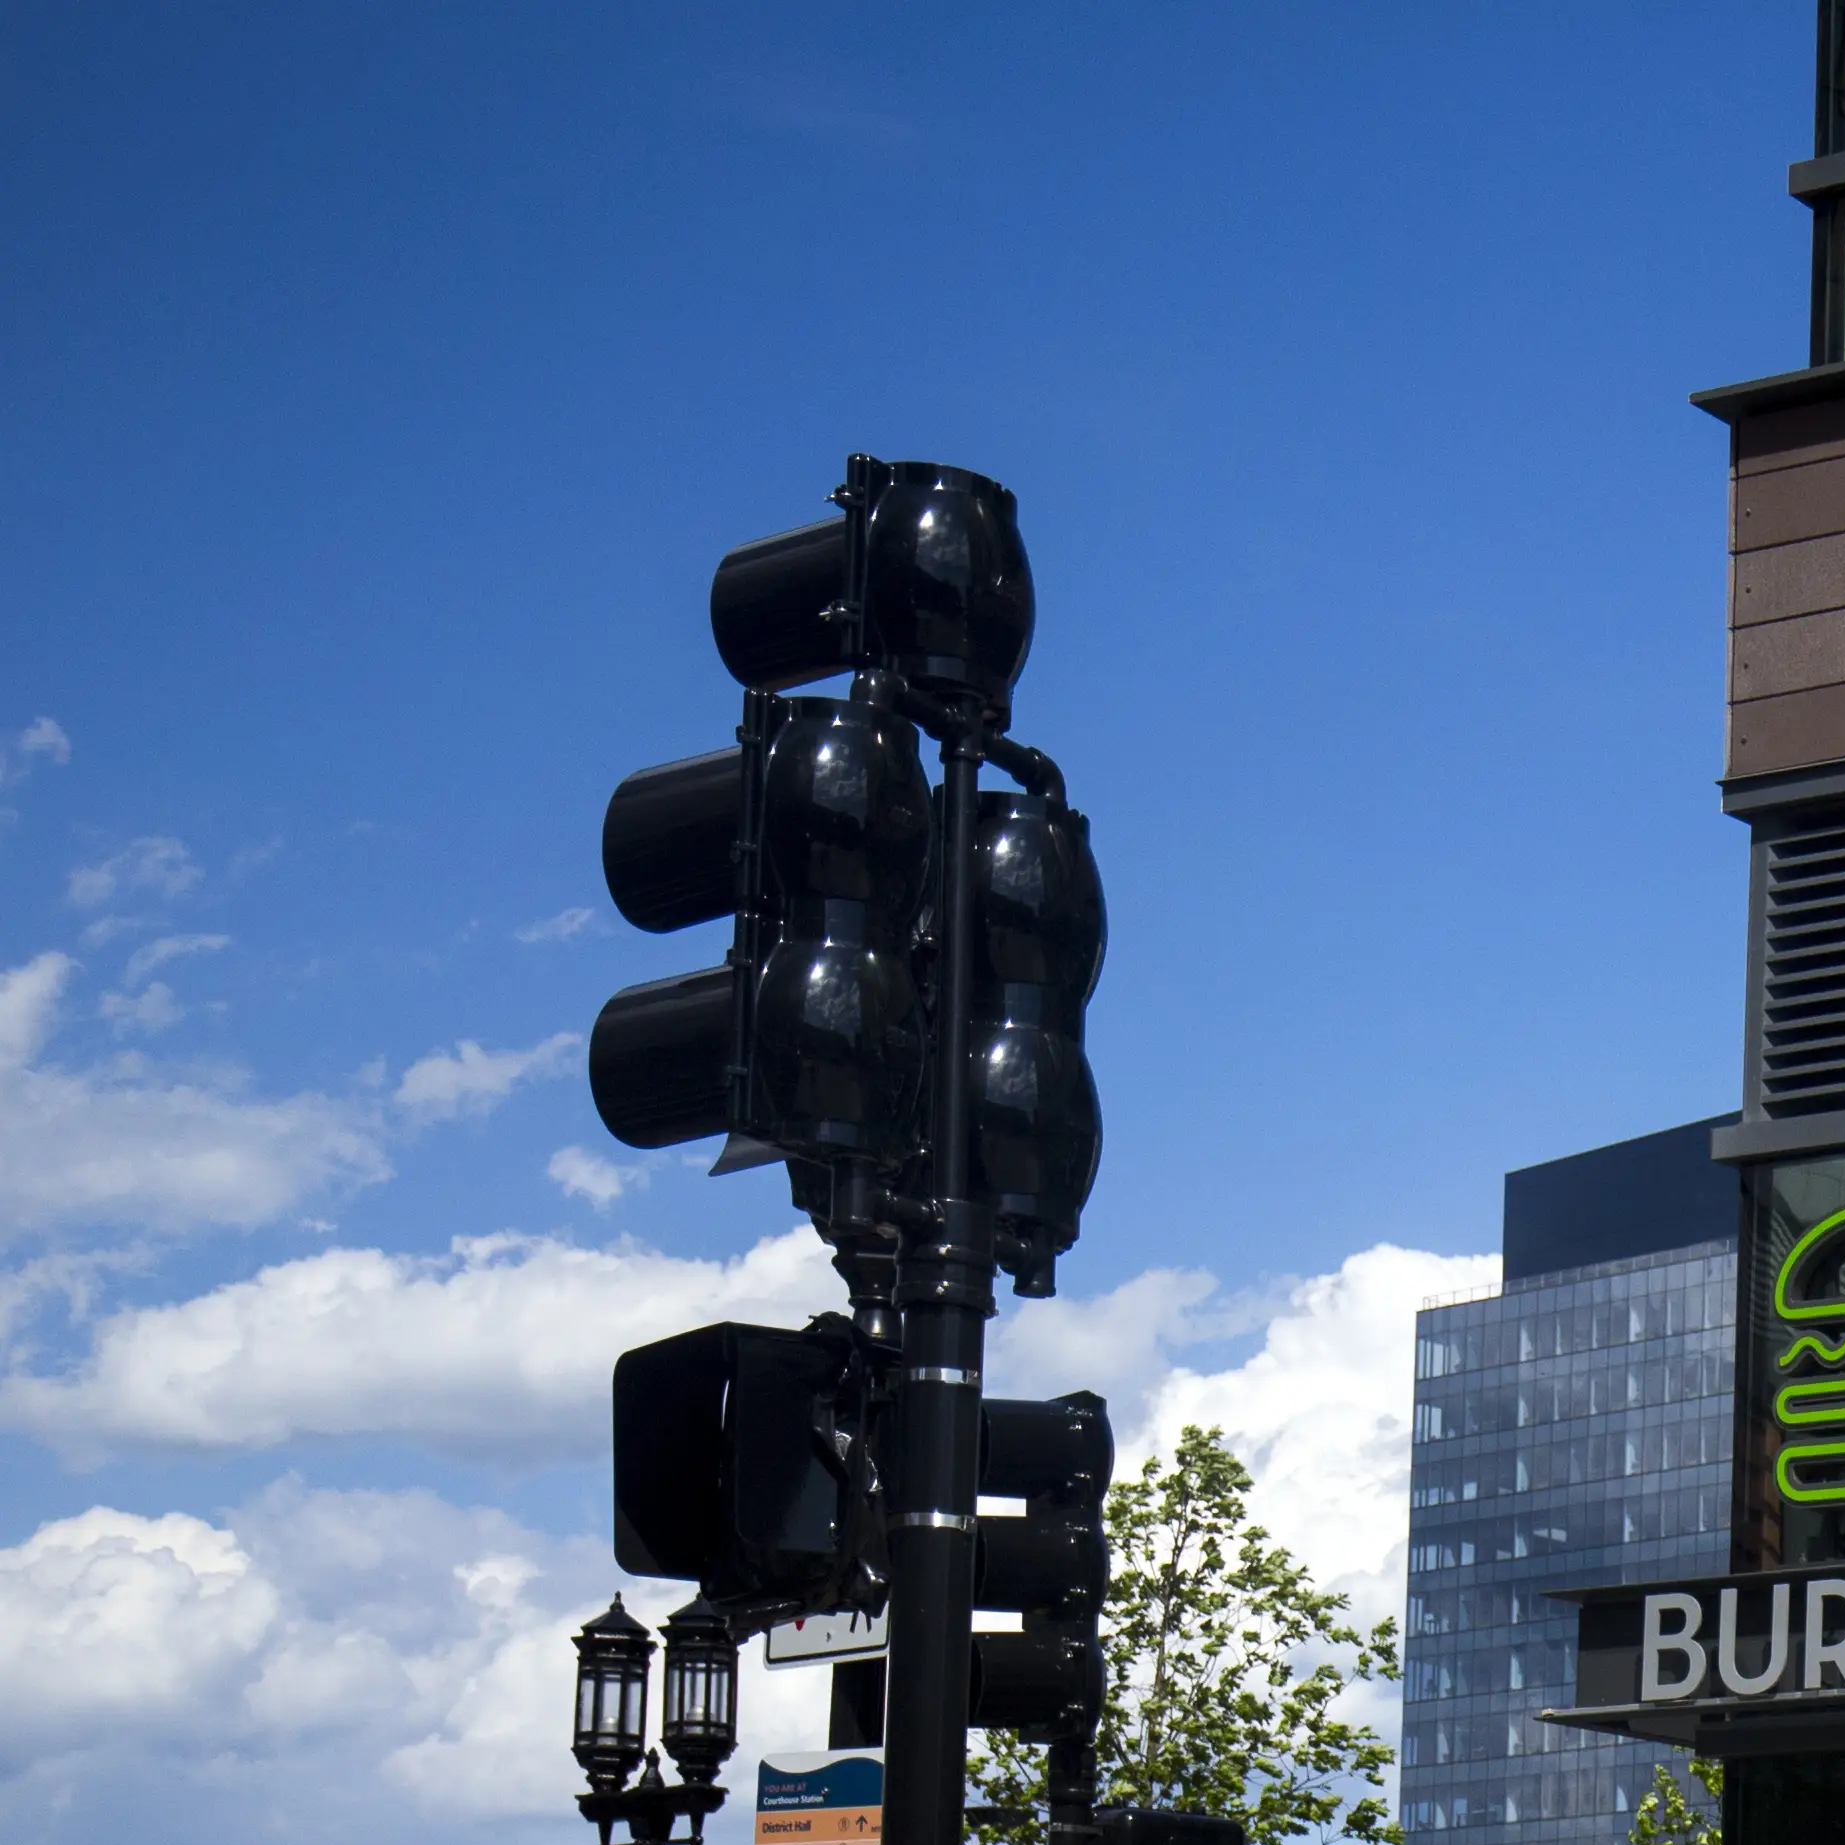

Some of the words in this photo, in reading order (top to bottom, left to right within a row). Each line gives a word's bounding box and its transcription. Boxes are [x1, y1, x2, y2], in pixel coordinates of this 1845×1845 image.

[763, 1796, 799, 1805] Courthouse
[800, 1794, 824, 1804] Station
[762, 1821, 793, 1834] District
[794, 1820, 812, 1832] Hall
